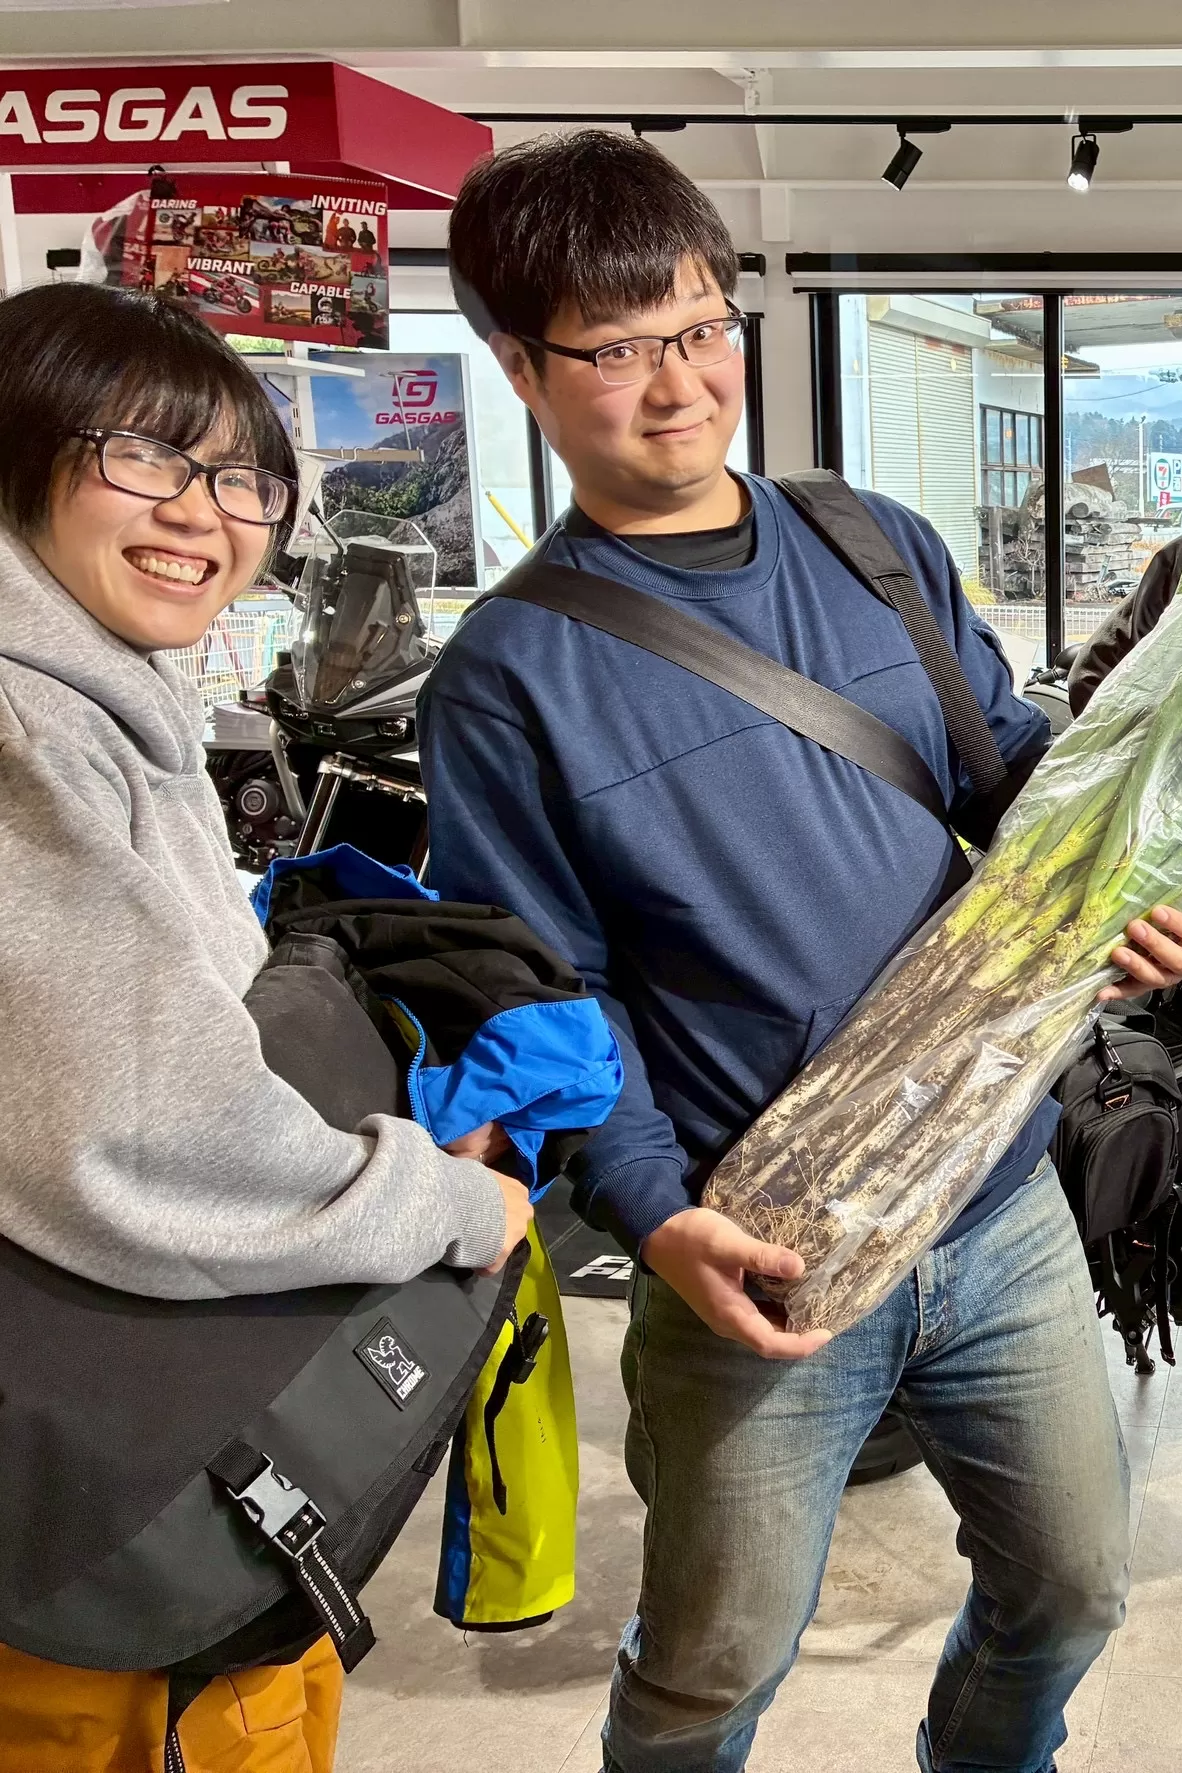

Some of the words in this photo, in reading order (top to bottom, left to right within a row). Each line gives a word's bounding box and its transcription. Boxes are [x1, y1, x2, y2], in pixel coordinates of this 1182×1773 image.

[151, 199, 197, 209] DARING
[311, 194, 387, 216] INVITING
[186, 257, 255, 275] VIBRANT
[290, 282, 352, 299] CAPABLE
[375, 411, 456, 425] GASGAS
[396, 1365, 425, 1399] CHROME
